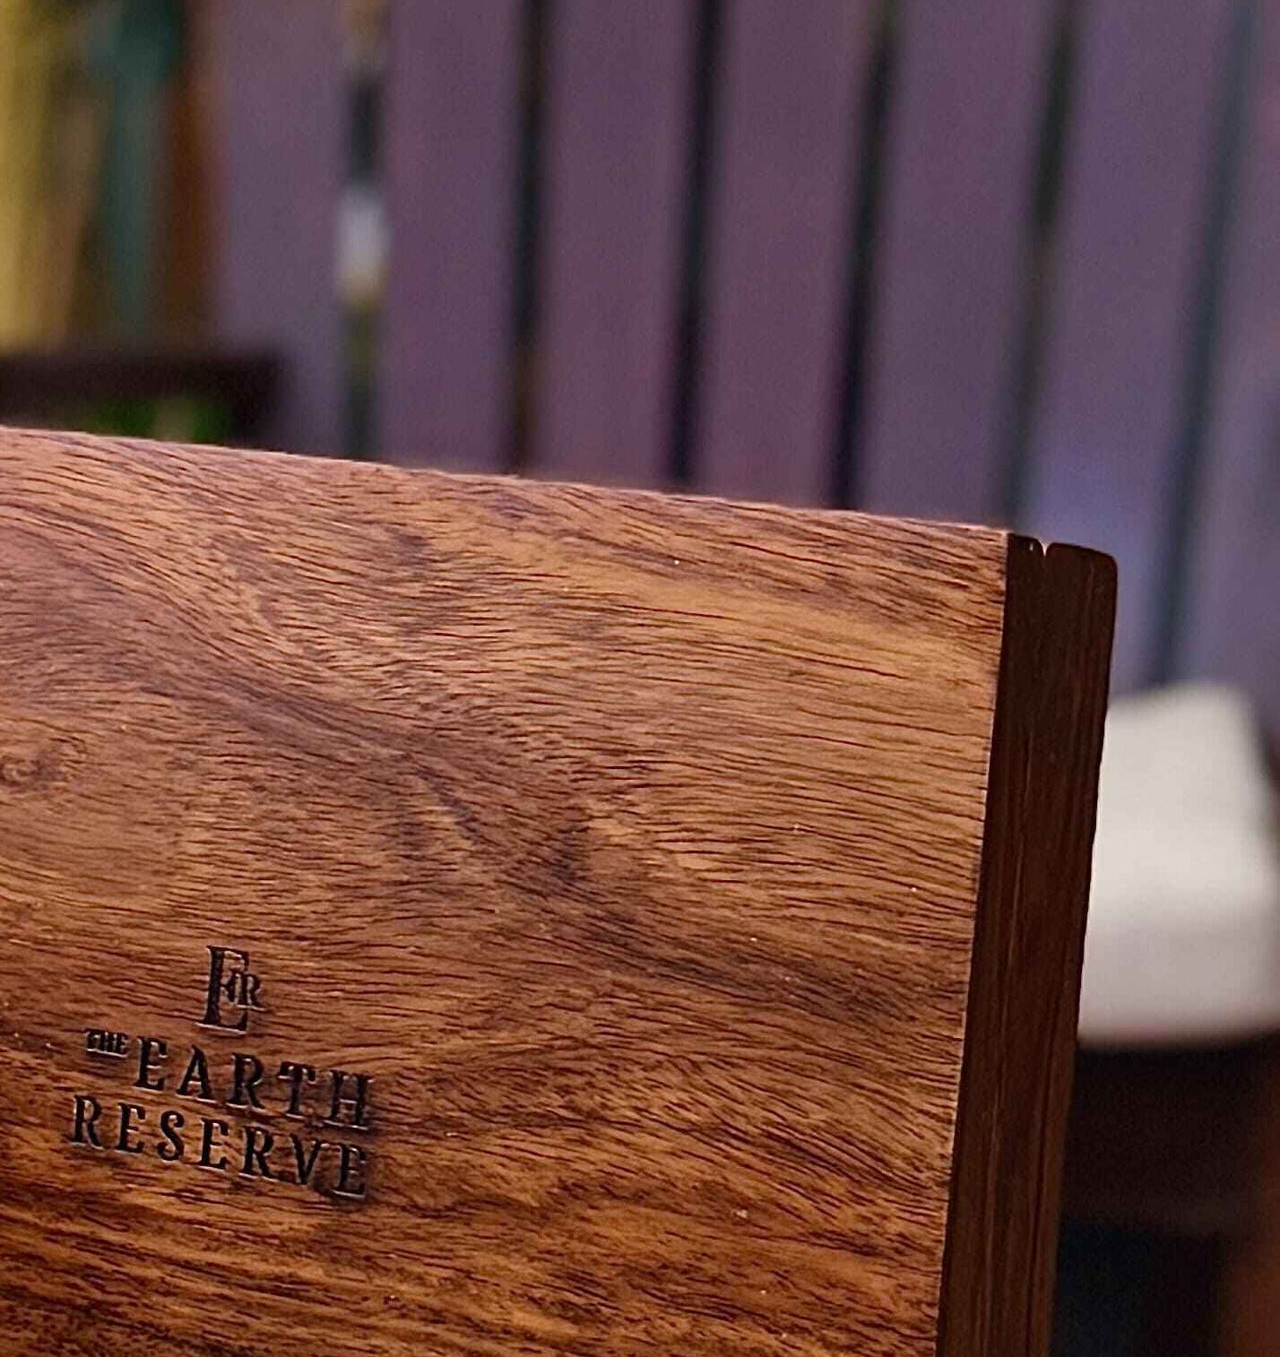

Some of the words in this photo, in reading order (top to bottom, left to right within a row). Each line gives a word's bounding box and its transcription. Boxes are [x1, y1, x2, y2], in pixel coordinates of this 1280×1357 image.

[84, 1027, 129, 1059] THE
[132, 1035, 374, 1131] EARTH
[71, 1094, 368, 1200] RESERVE
